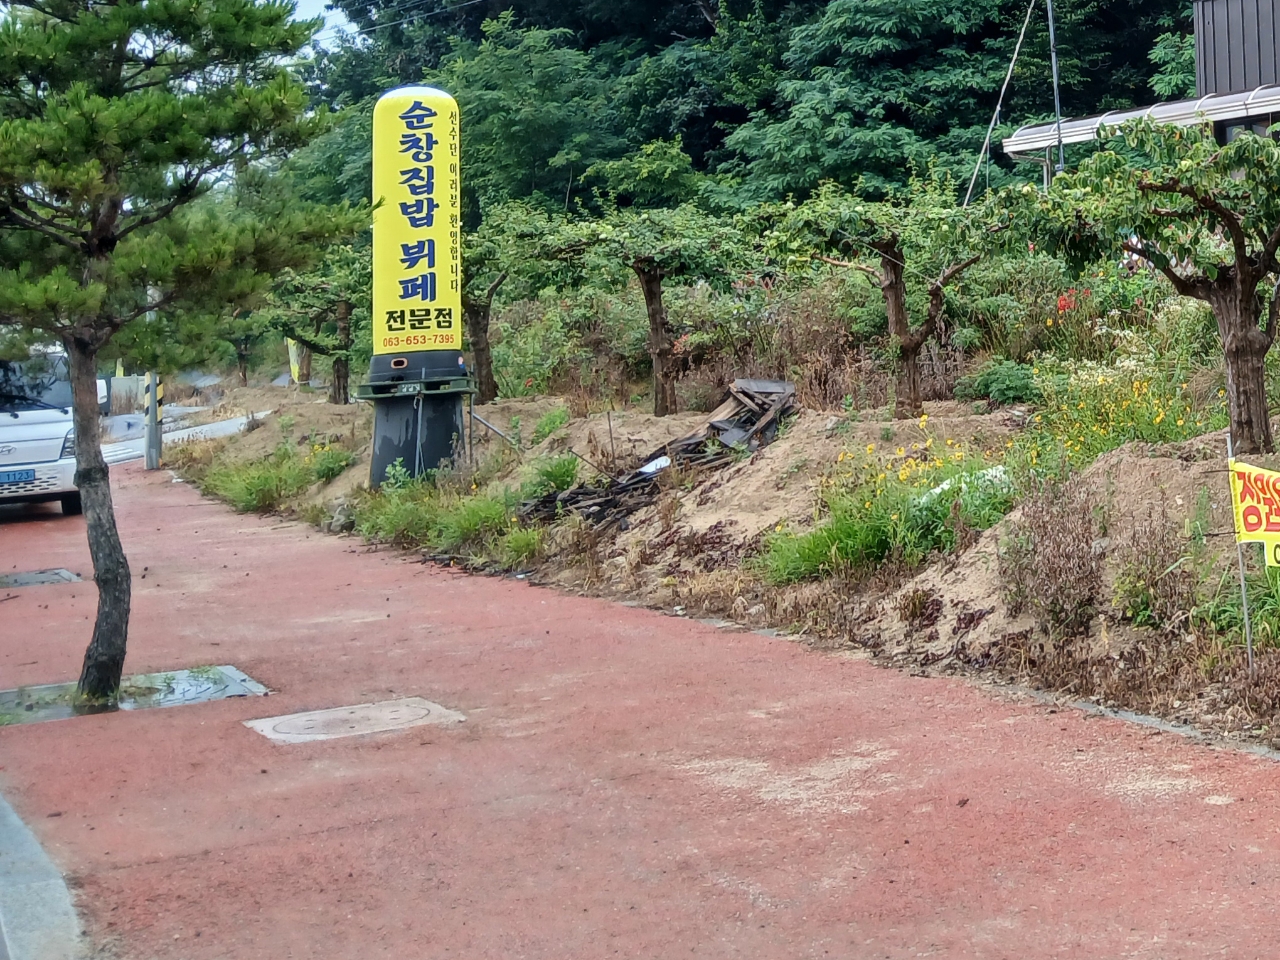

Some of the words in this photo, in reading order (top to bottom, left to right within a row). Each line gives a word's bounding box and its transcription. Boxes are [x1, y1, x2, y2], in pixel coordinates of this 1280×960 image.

[398, 100, 440, 229] 순창집밥
[398, 238, 437, 303] 뷔페
[385, 307, 453, 332] 전문점
[382, 333, 455, 348] 063-653-7395
[6, 472, 30, 481] 1123
